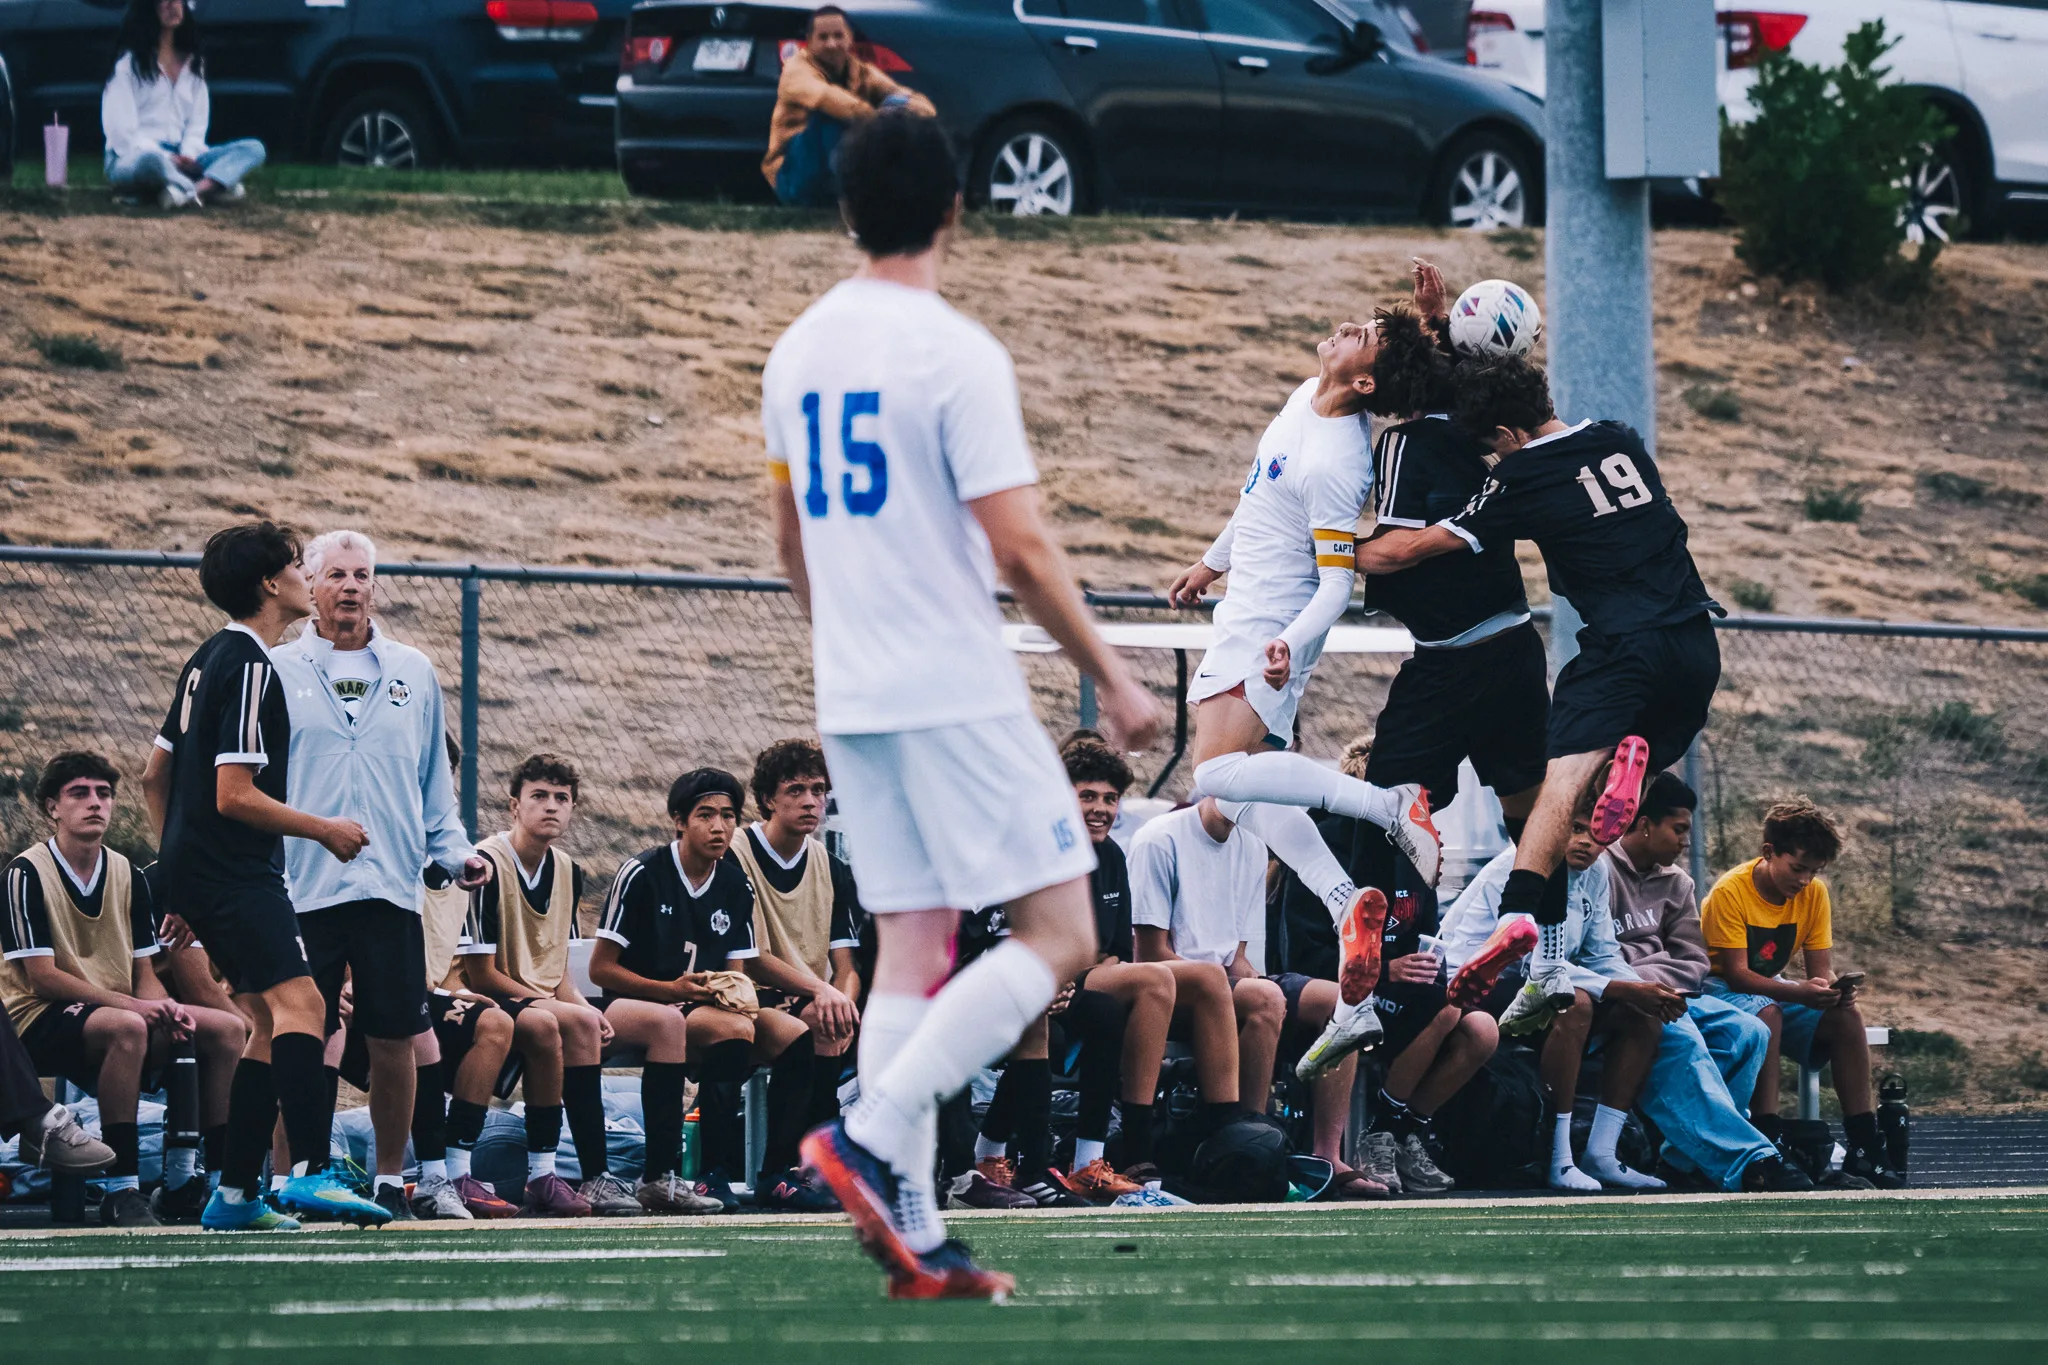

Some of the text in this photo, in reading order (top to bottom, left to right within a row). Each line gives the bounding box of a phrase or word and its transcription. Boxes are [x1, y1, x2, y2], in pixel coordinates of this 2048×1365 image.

[801, 391, 888, 517] 15
[1575, 452, 1653, 518] 19
[1333, 543, 1355, 554] CAPT
[335, 680, 371, 697] NAR
